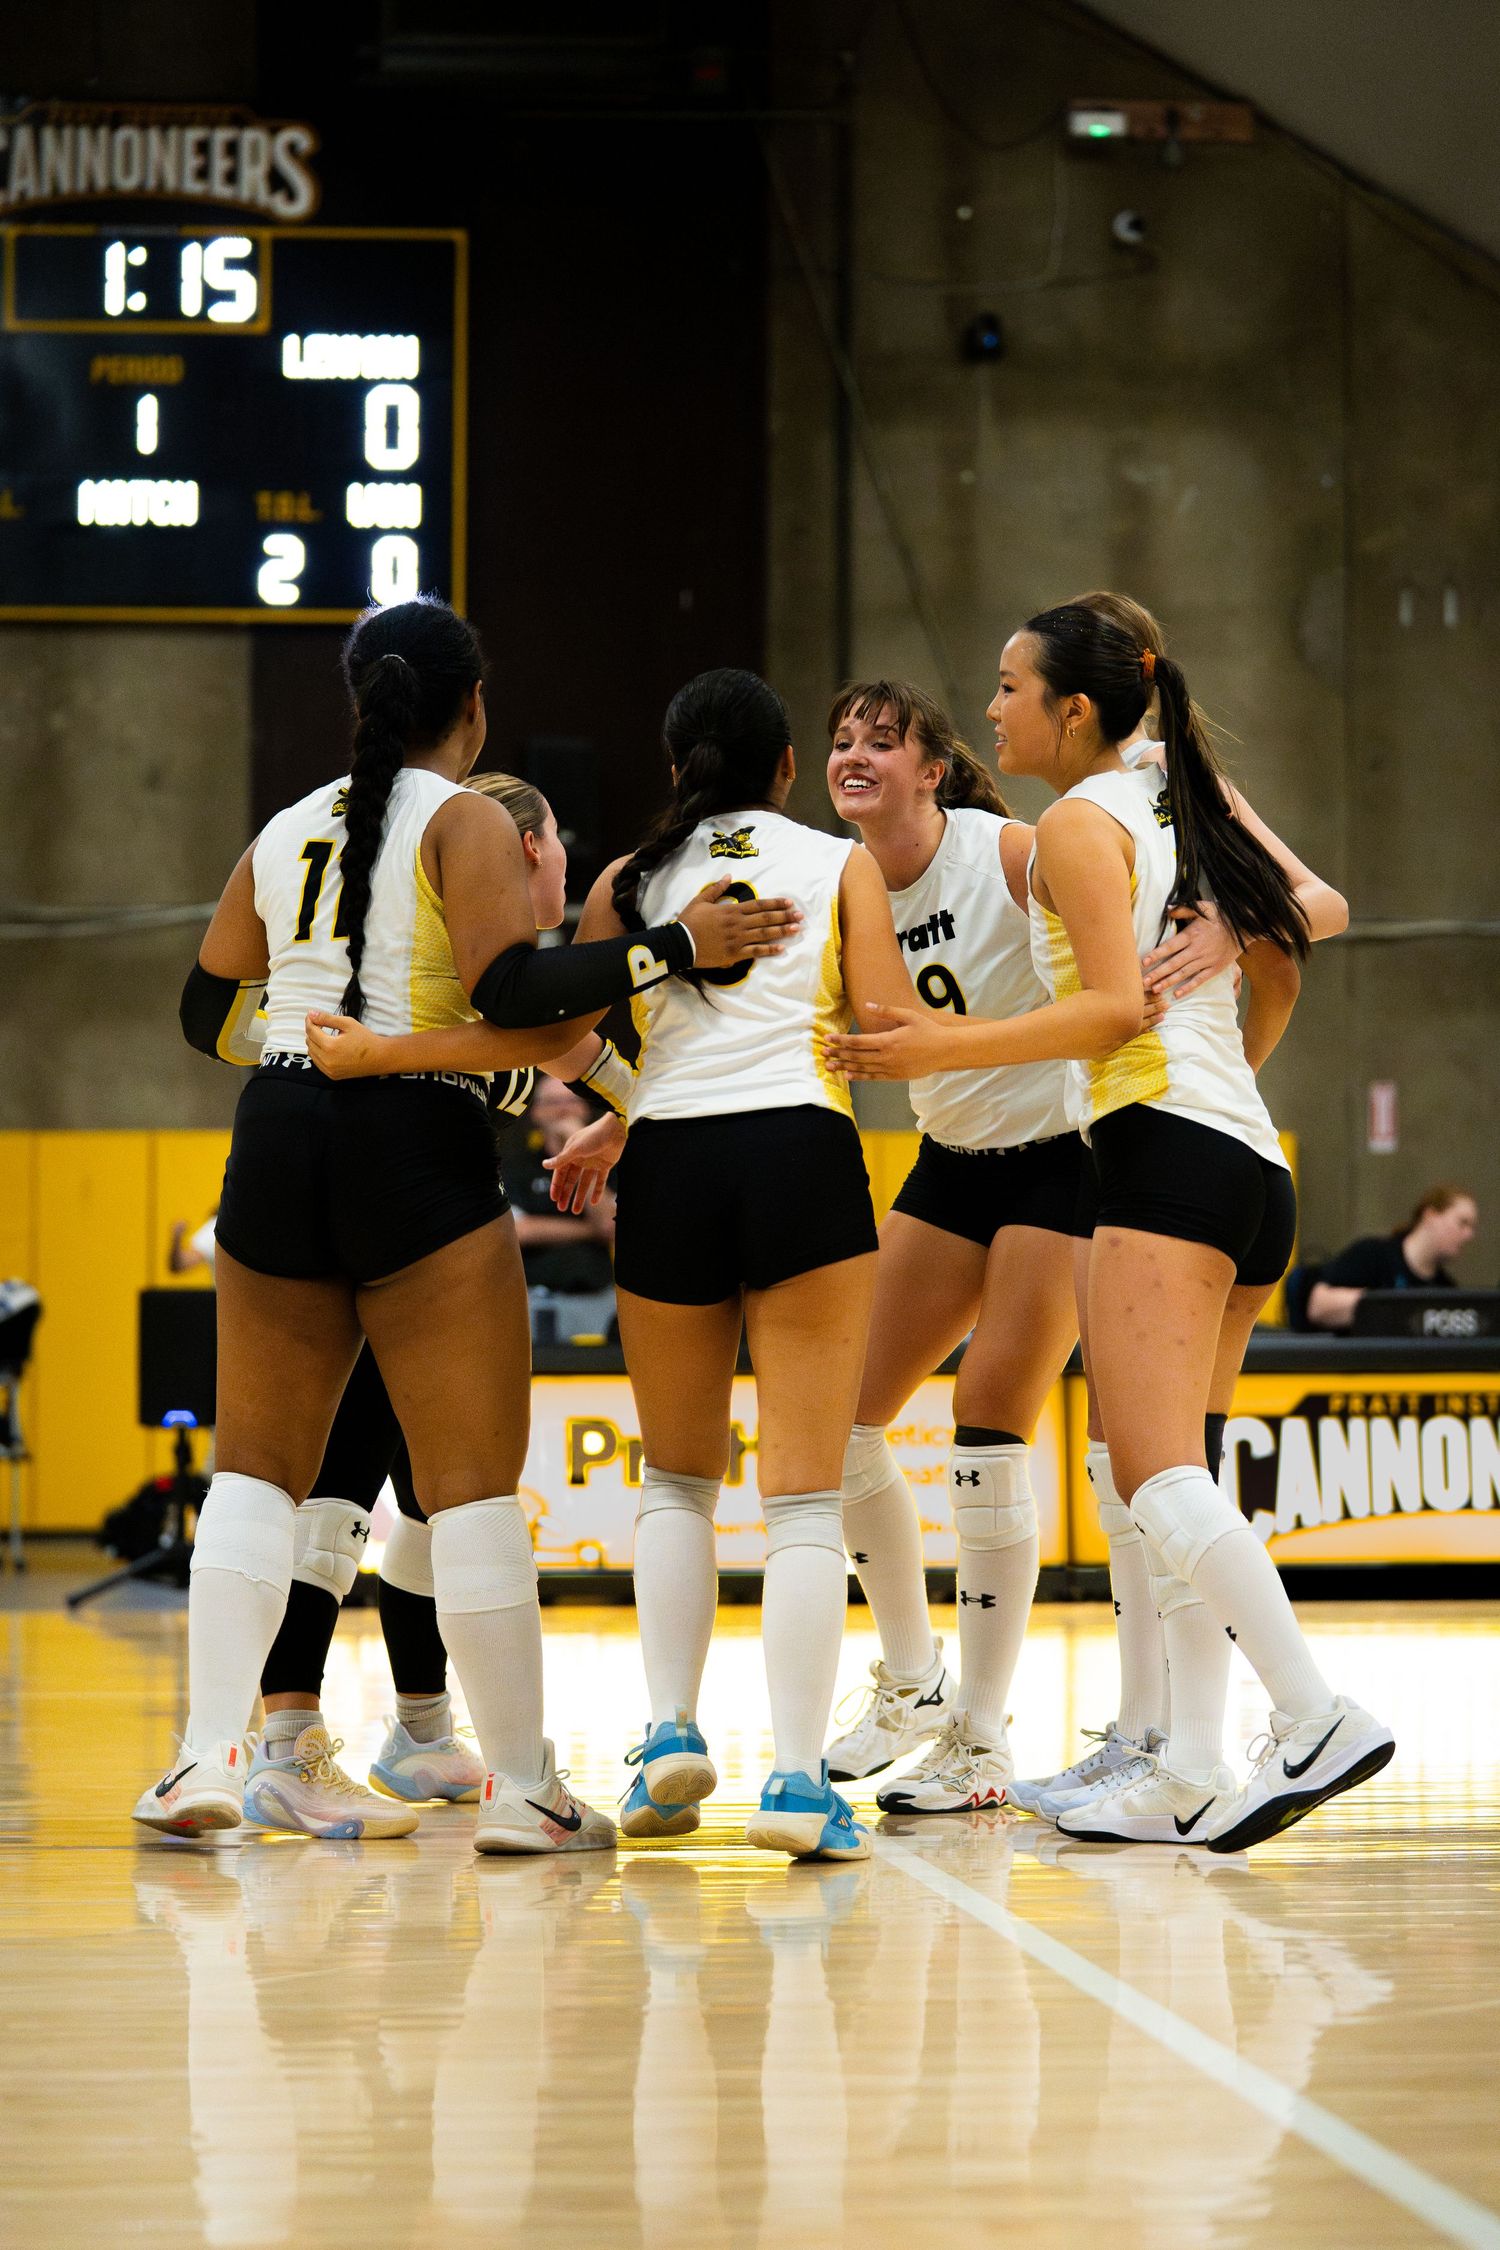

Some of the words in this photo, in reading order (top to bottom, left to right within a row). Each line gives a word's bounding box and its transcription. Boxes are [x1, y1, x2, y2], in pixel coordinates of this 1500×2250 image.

[0, 122, 315, 220] ANNONEERS
[91, 355, 185, 384] PERIOD
[258, 534, 305, 605] 2
[896, 909, 956, 955] ratt
[627, 944, 669, 988] P
[915, 961, 968, 1016] 9
[1423, 1309, 1479, 1337] POSS
[1329, 1394, 1419, 1415] PRATT
